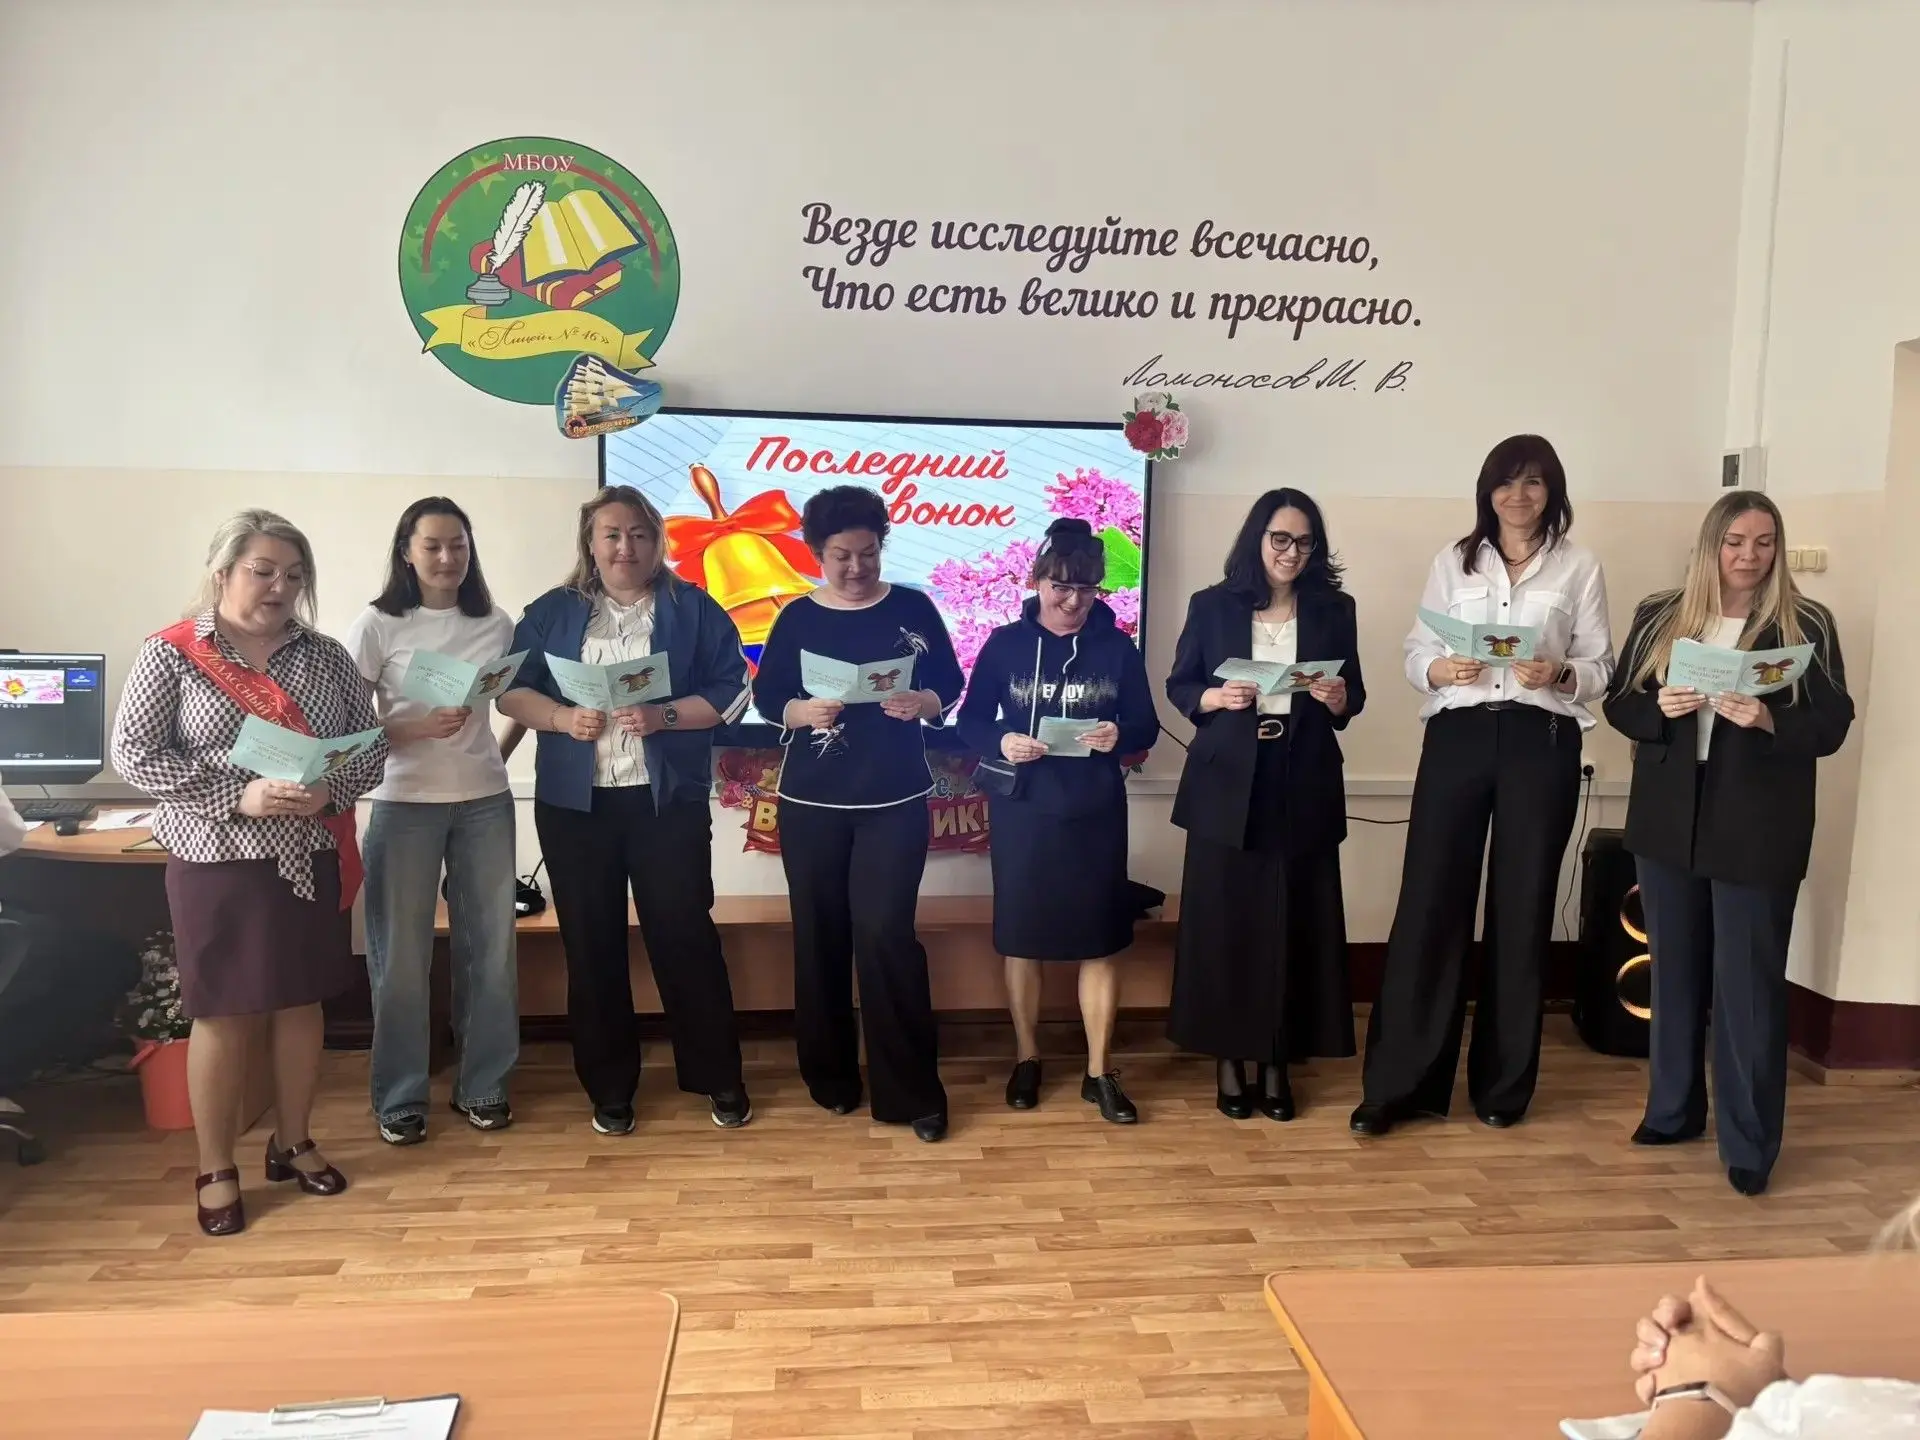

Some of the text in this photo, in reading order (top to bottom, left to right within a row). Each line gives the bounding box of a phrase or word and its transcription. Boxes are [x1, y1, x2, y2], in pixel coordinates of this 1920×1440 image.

[503, 153, 575, 172] МБОУ
[802, 203, 1378, 274] Везде исследуйте всечасно,
[803, 266, 1421, 340] Что есть велико и прекрасно.
[1122, 354, 1413, 393] Ломоносов М. В.
[746, 436, 1009, 495] Последний
[888, 483, 1016, 527] вонок
